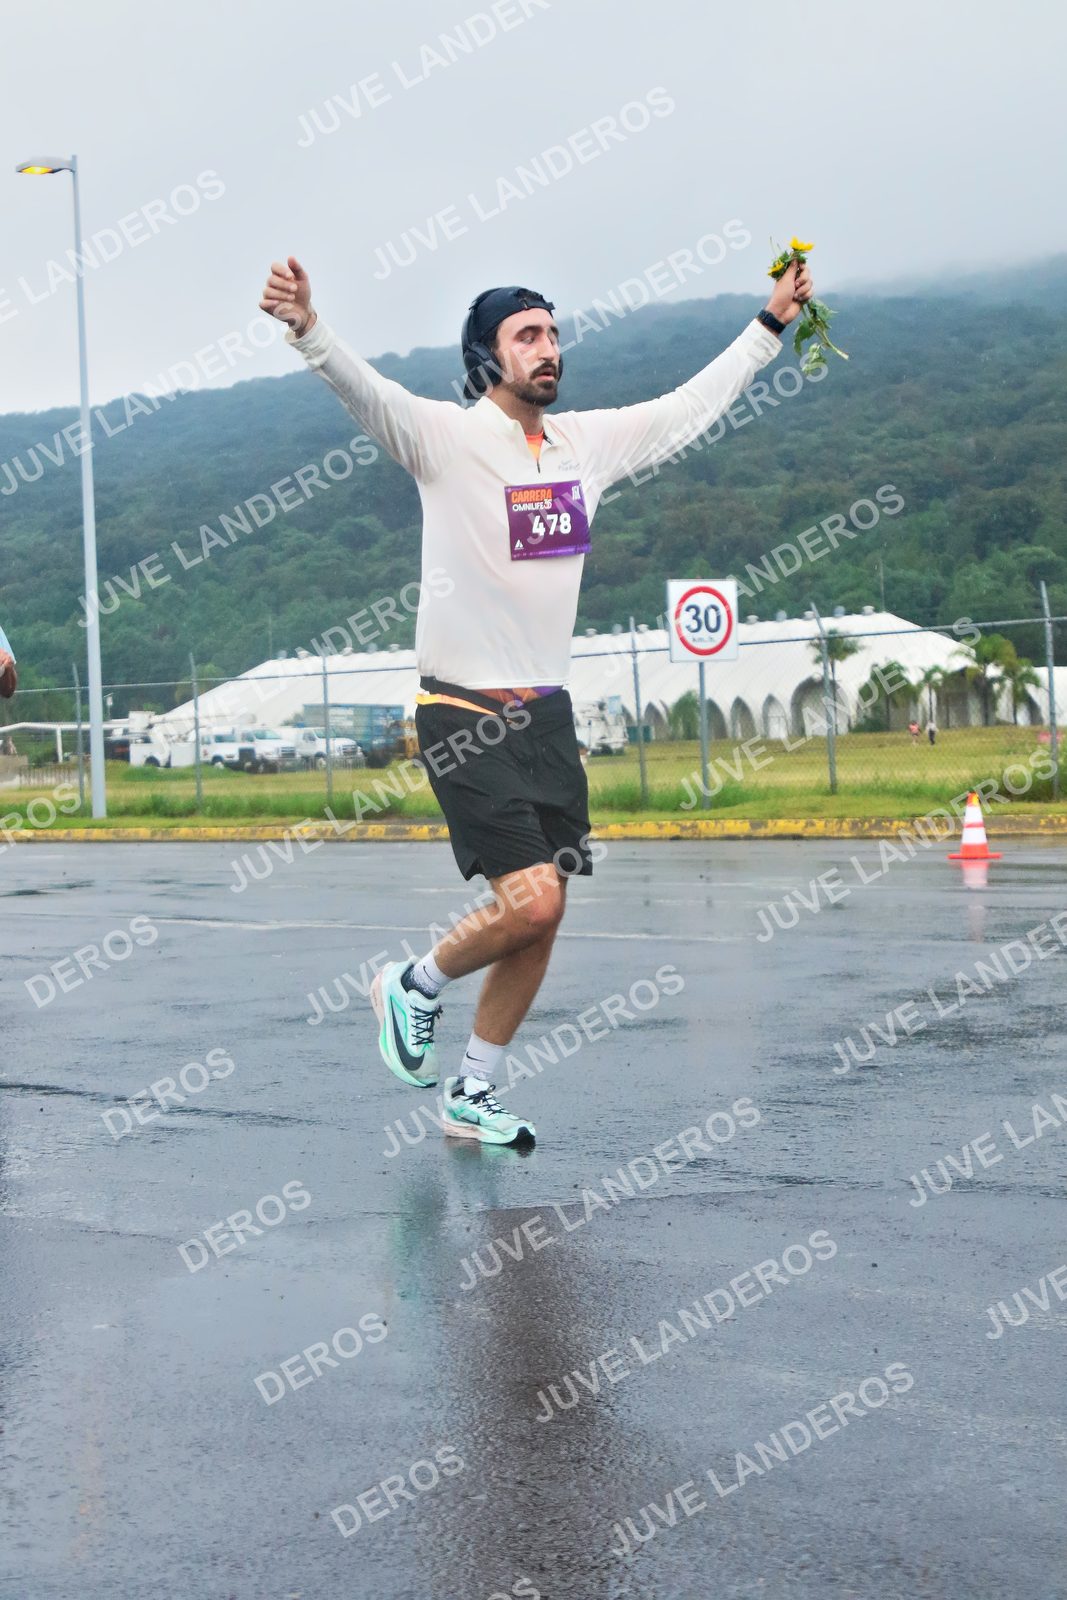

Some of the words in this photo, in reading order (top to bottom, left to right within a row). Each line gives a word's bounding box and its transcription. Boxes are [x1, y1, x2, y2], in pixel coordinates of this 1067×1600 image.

[511, 488, 552, 503] CARRERA
[532, 512, 571, 536] 478
[685, 604, 721, 633] 30
